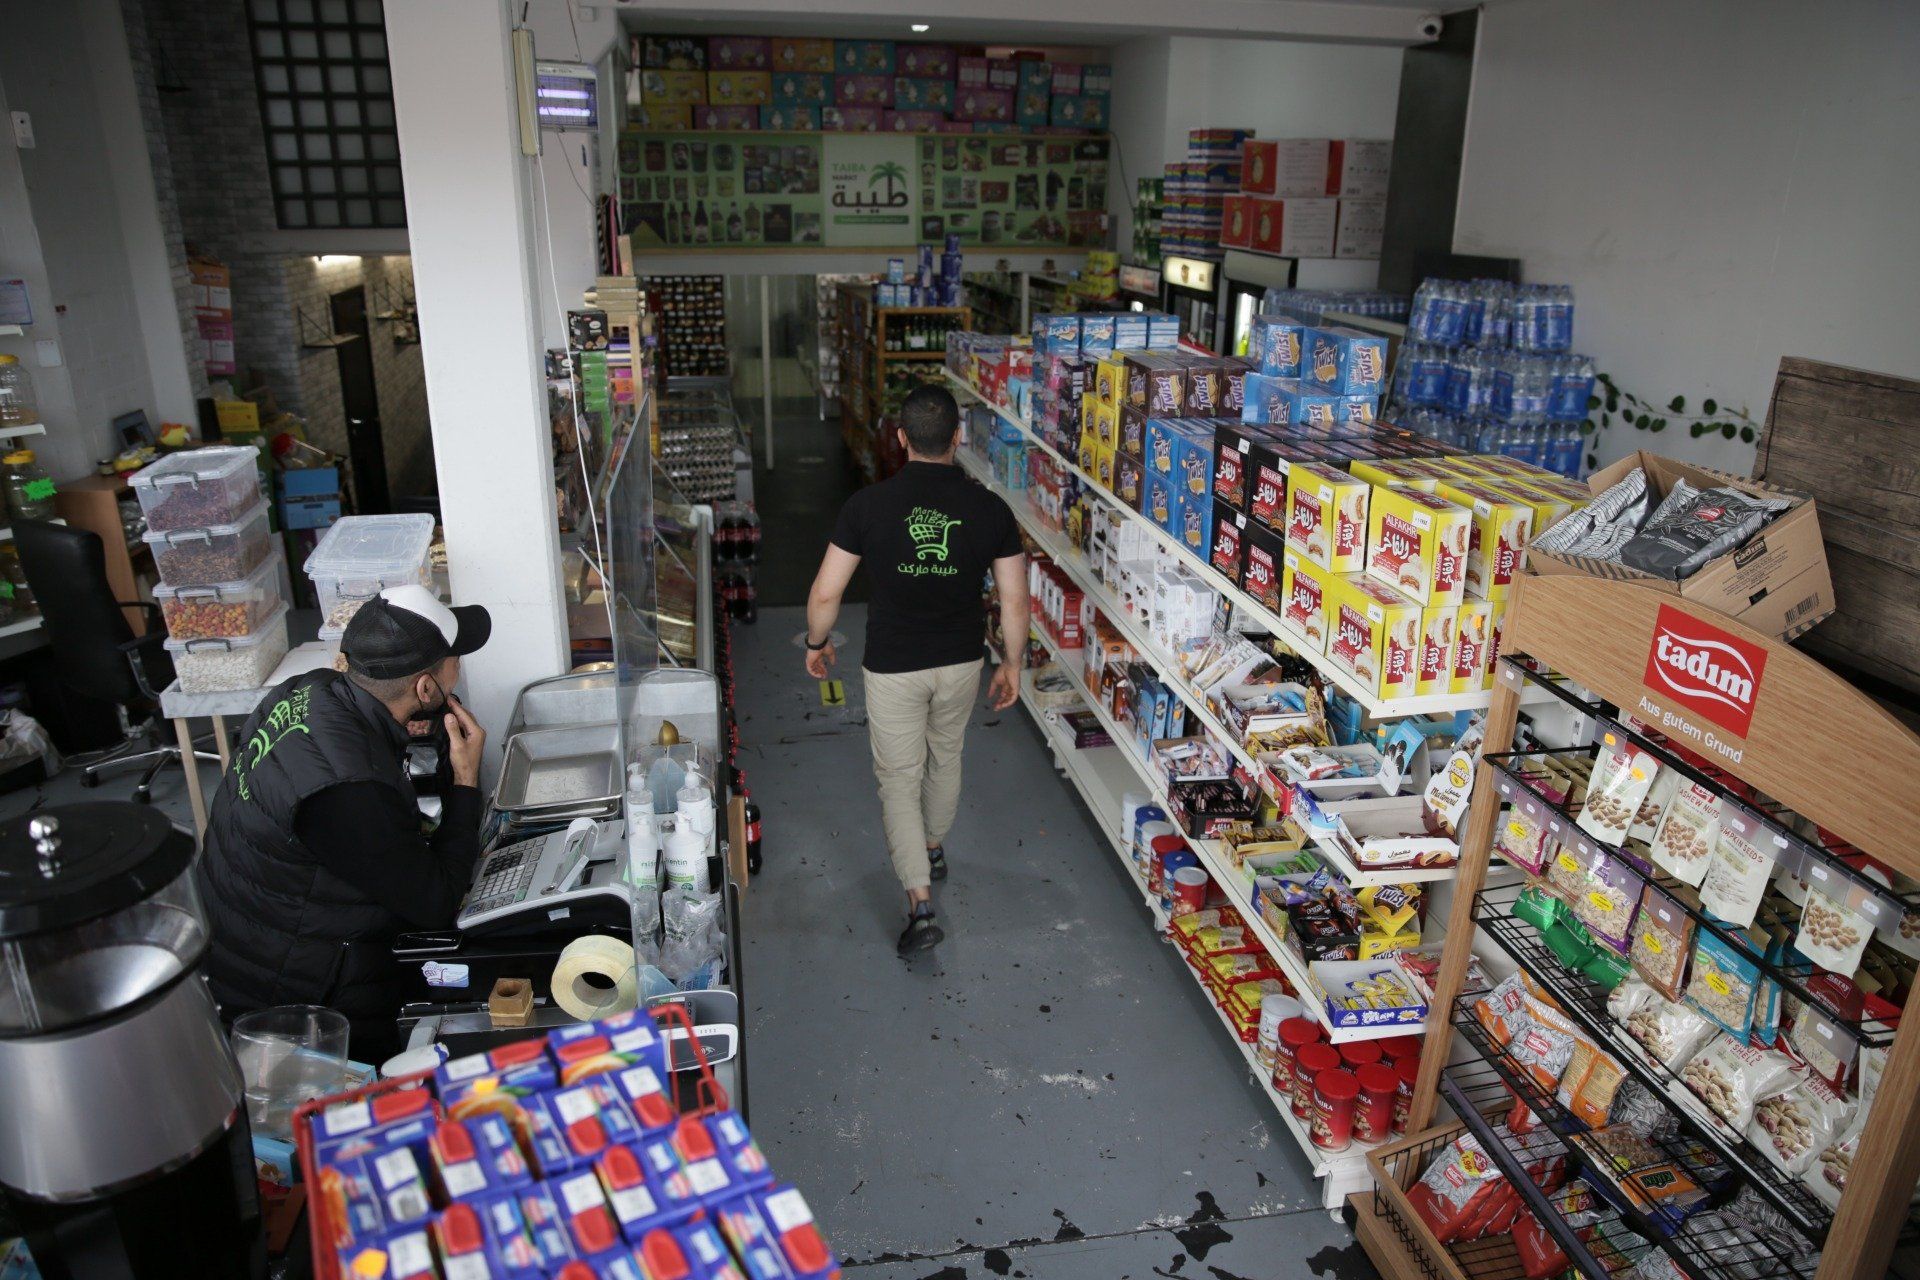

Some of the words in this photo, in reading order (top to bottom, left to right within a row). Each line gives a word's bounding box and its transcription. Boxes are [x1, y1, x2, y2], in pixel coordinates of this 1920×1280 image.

[832, 163, 866, 172] TAIBA
[904, 514, 947, 529] TAIBA
[912, 507, 949, 521] Market
[1386, 513, 1418, 539] ALFAKHR
[898, 563, 929, 577] ماركت
[931, 564, 958, 576] طيبة
[1638, 695, 1660, 717] Aus
[1662, 711, 1701, 741] gutem
[1704, 732, 1743, 764] Grund
[1679, 788, 1702, 807] ASHEW
[1703, 803, 1720, 819] NUTS
[1742, 842, 1763, 863] SEEDS
[1733, 1042, 1754, 1067] SHELL
[1808, 1080, 1833, 1105] SHELL
